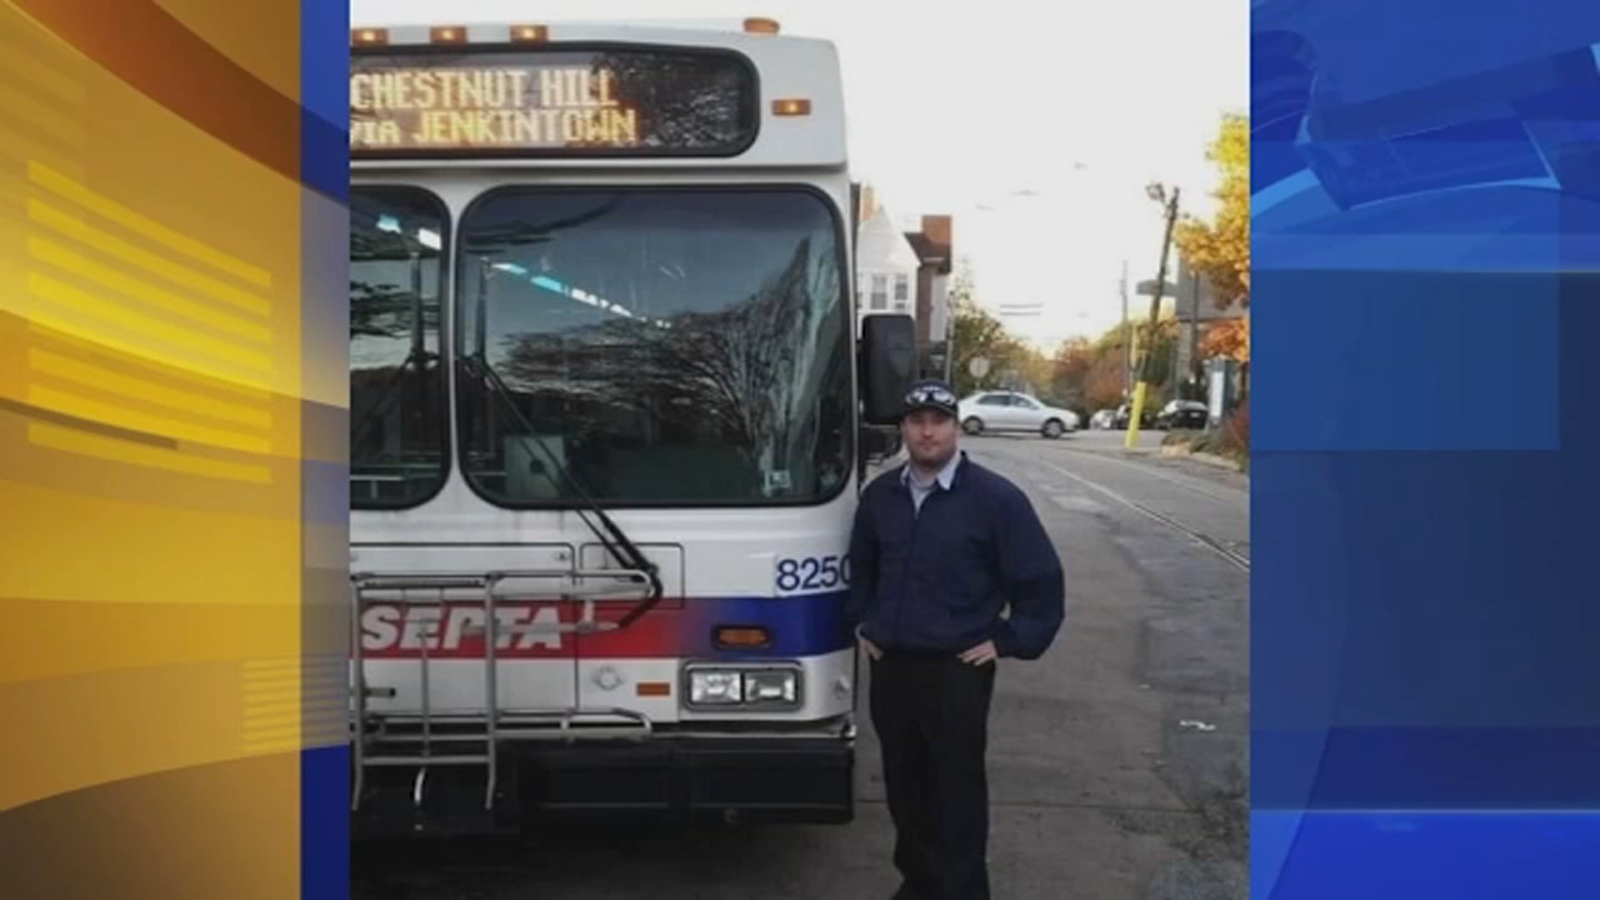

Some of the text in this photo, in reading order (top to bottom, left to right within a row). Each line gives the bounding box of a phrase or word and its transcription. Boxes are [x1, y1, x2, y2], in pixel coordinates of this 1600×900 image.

[350, 69, 619, 109] CHESTNUT HILL
[412, 109, 636, 142] JENKINTOWN
[361, 605, 562, 650] SEPTA
